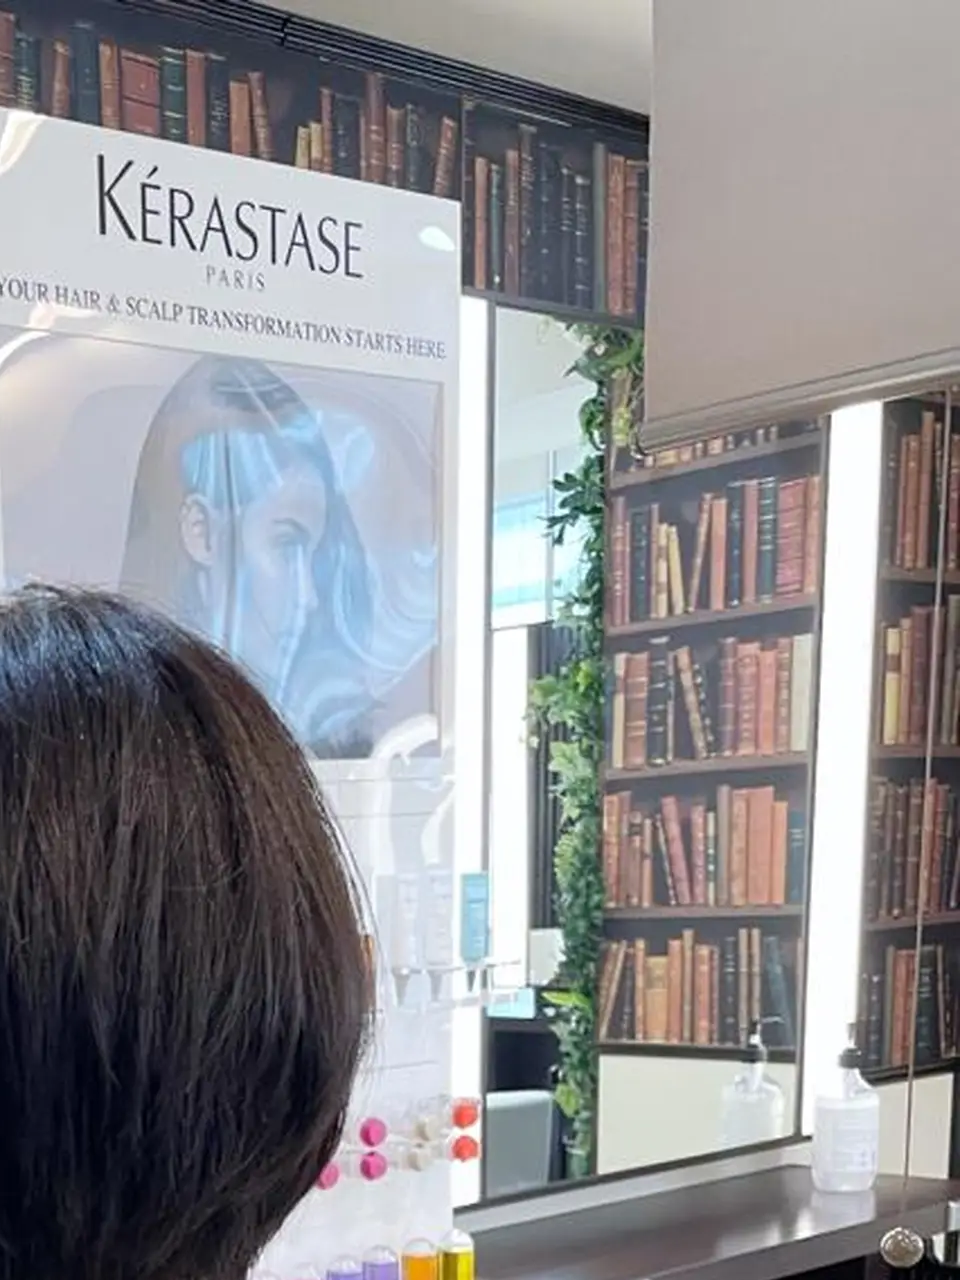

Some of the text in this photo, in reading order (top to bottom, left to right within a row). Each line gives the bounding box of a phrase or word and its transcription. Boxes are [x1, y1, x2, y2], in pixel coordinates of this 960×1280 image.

[97, 153, 364, 279] KÉRASTASE
[205, 264, 266, 293] PARIS
[54, 284, 102, 312] HAIR
[106, 293, 122, 314] &
[125, 295, 184, 323] SCALP
[188, 304, 341, 344] TRANSFORMATION
[344, 328, 404, 355] STARTS
[405, 336, 447, 360] HERE
